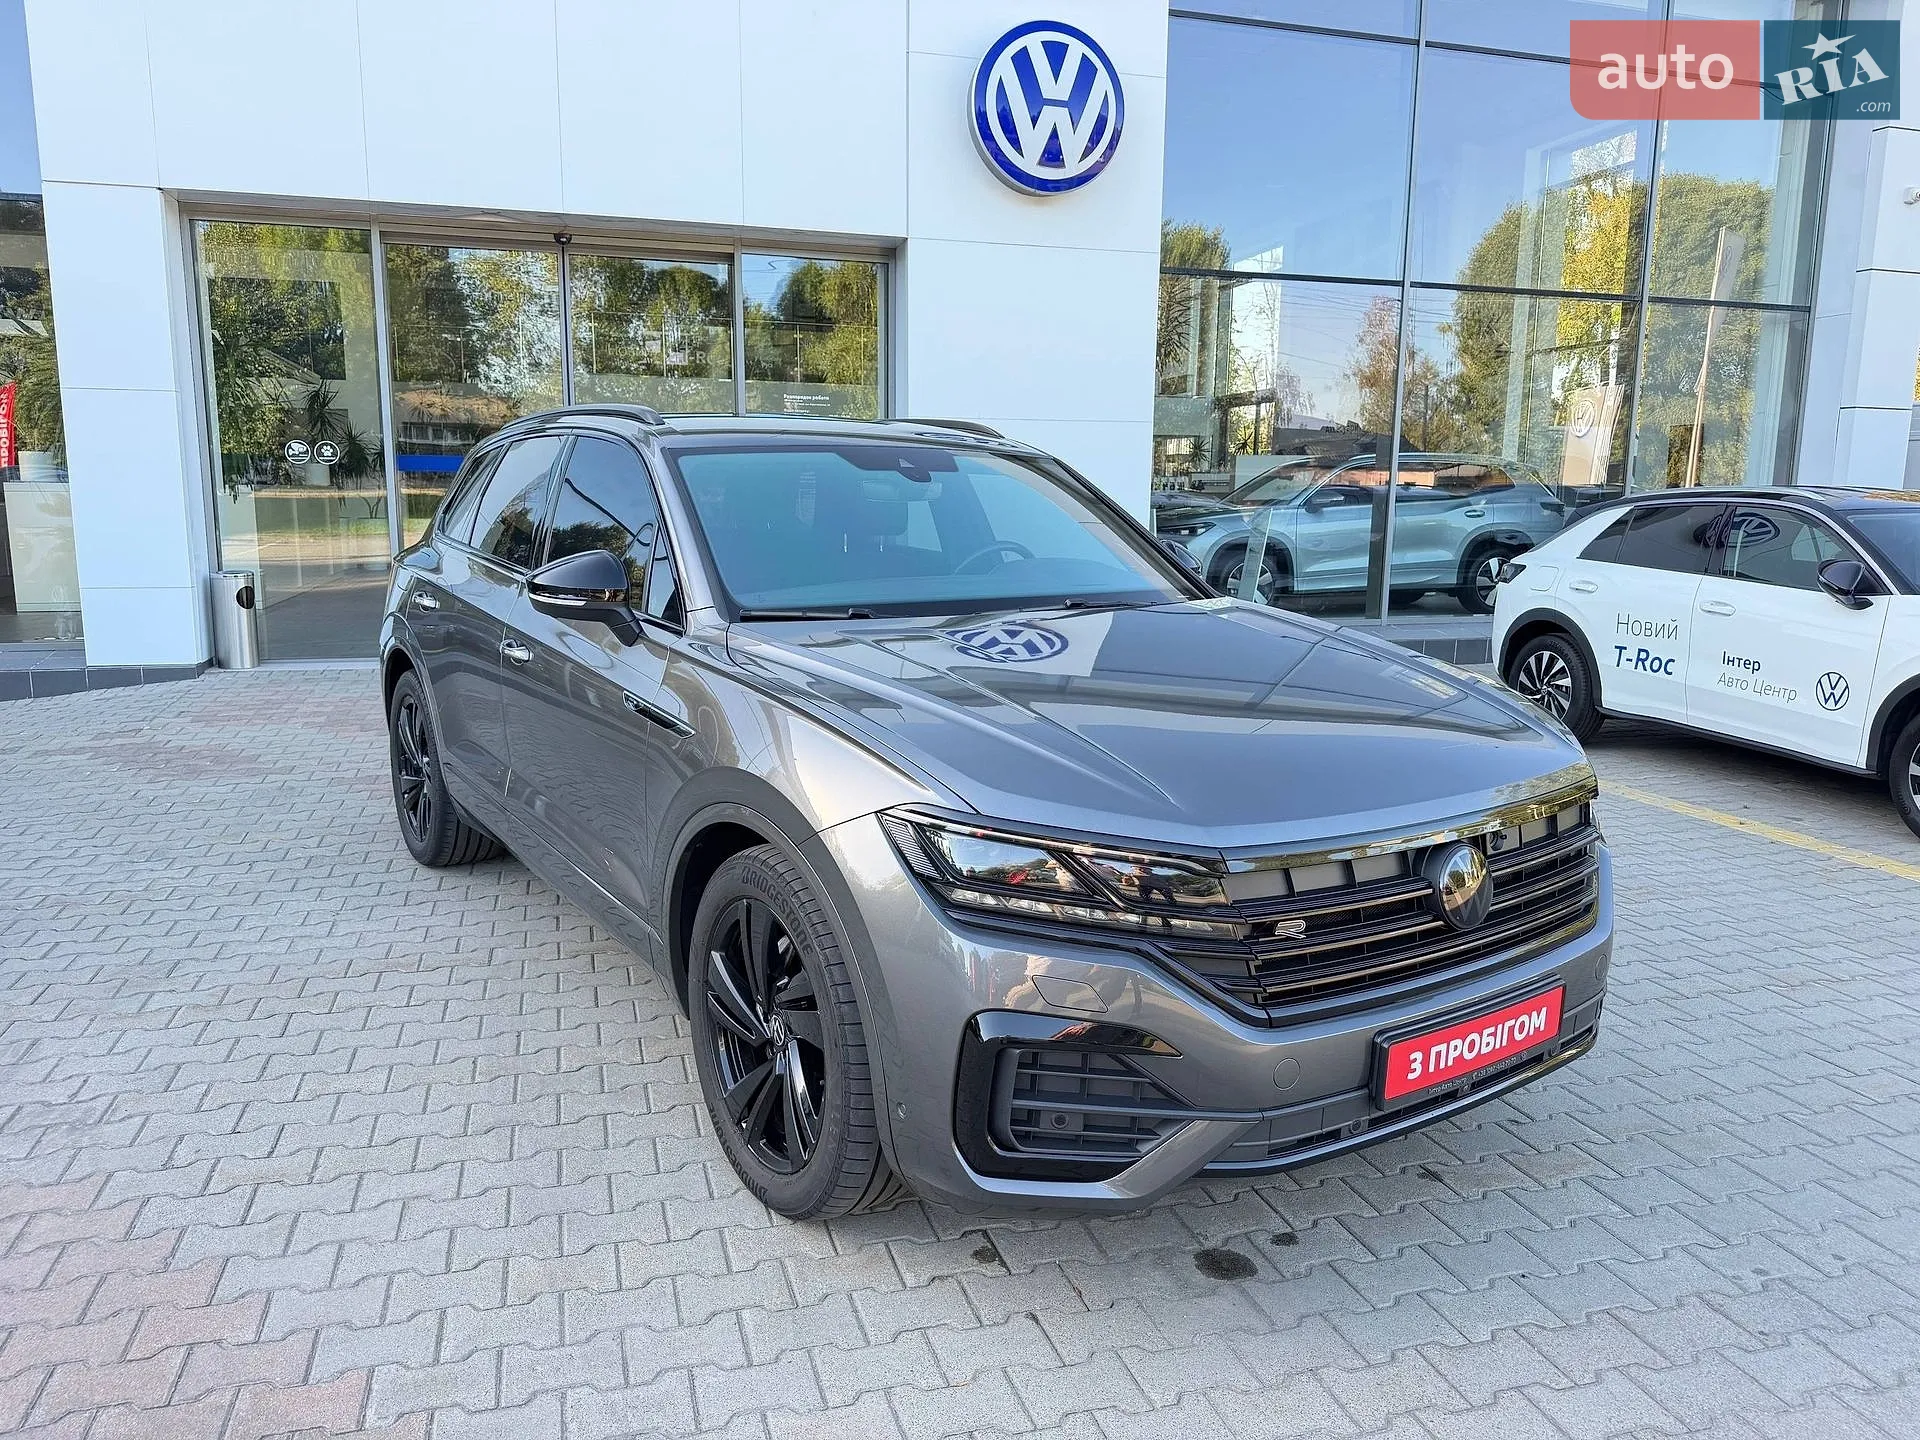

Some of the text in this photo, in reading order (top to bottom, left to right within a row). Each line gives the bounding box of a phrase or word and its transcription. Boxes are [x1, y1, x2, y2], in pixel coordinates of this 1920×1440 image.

[1616, 613, 1679, 641] Новий
[1614, 645, 1676, 676] T-Roc
[1722, 651, 1761, 675] Інтер
[1717, 672, 1797, 704] Авто Центр
[1428, 1006, 1547, 1073] ПРОБІГОМ
